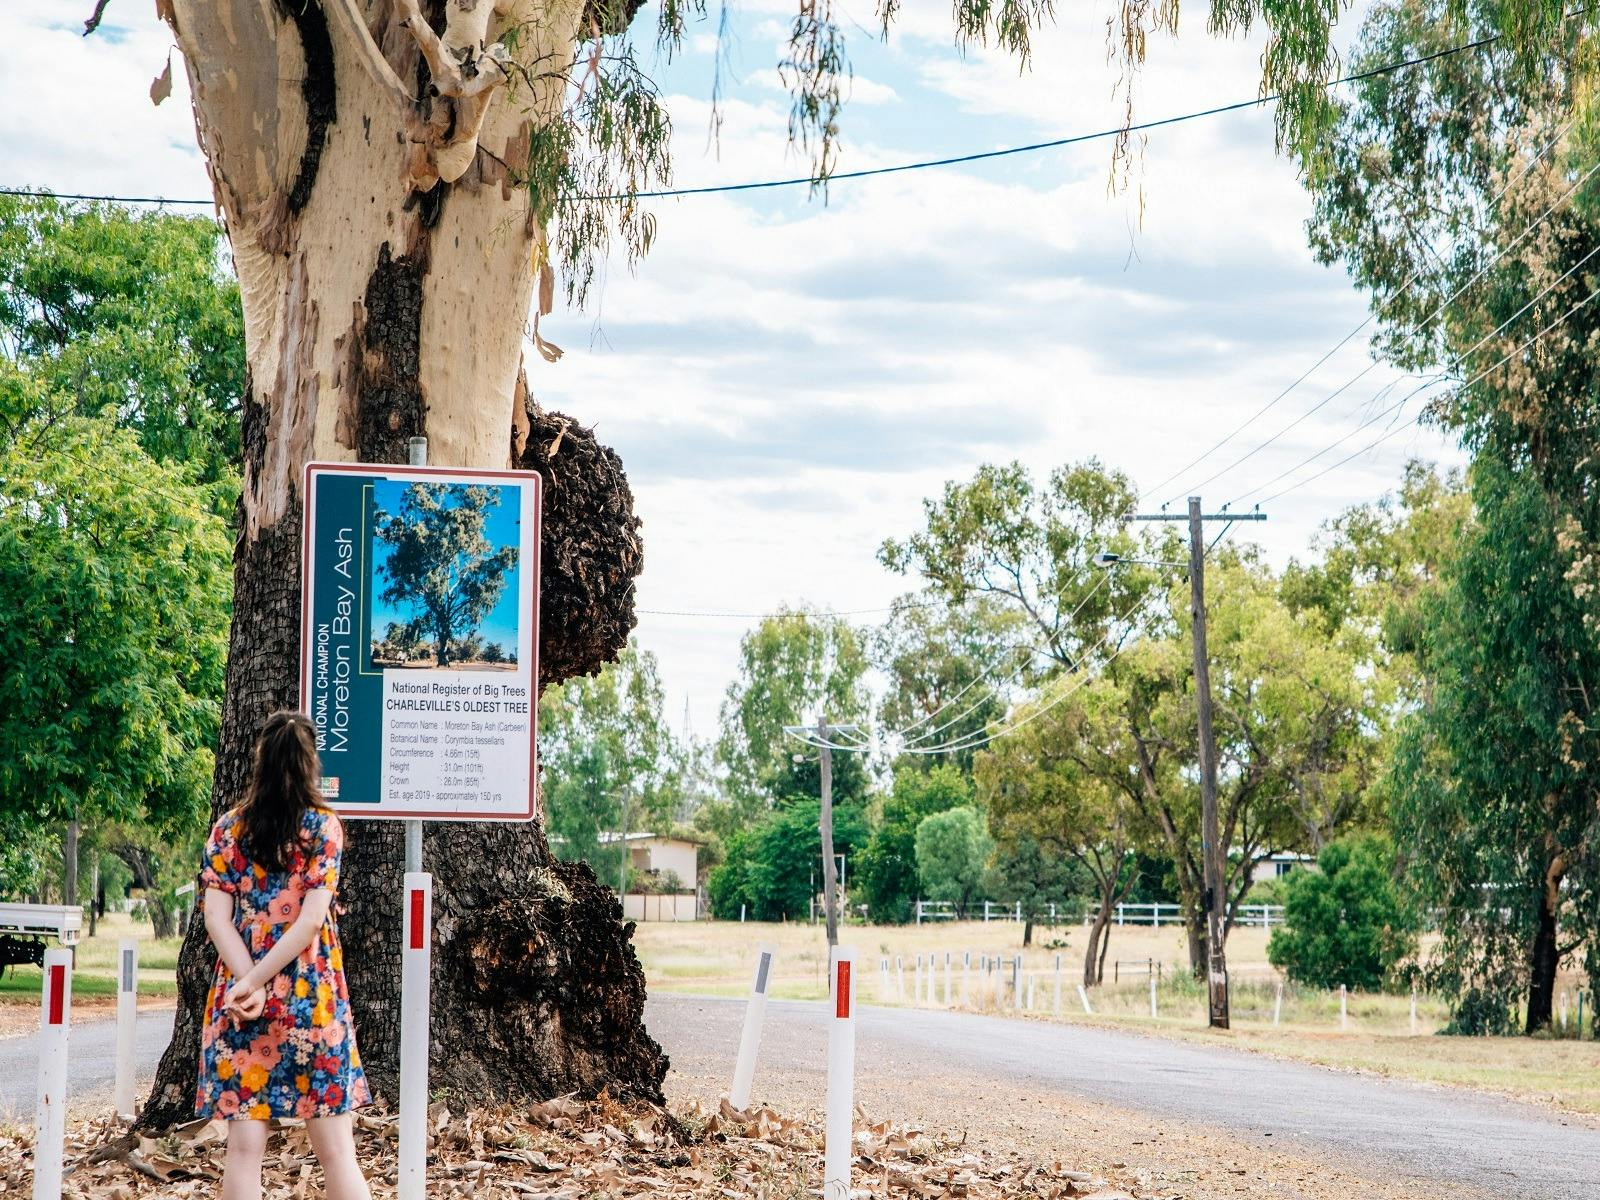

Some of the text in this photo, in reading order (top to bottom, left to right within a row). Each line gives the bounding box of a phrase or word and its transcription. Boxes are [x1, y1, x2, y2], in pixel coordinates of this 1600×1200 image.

[330, 528, 355, 752] Moreton Bay Ash
[315, 623, 329, 751] NATIONAL CHAMPION
[392, 682, 526, 699] National Register of Big Trees
[386, 699, 529, 714] CHARLEVILLE'S OLDEST TREE
[390, 719, 419, 730] Common
[420, 720, 438, 730] Name
[444, 720, 470, 731] Moreton
[471, 721, 484, 733] Bay
[484, 722, 496, 732] Ash
[497, 721, 527, 733] (Carbeen)
[390, 733, 419, 744] Botanical
[420, 734, 438, 744] Name
[444, 734, 474, 747] Corymbia
[389, 747, 434, 758] Circumference
[464, 749, 481, 760] (15ft)
[389, 761, 410, 773] Height
[443, 762, 463, 772] 31.0m
[464, 763, 484, 774] (101ft)
[389, 775, 410, 785] Crown
[443, 776, 463, 786] 26.0m
[388, 789, 400, 800] Est.
[402, 792, 414, 802] age
[414, 790, 431, 800] 2019
[435, 791, 478, 802] approximately
[480, 791, 492, 801] 150
[492, 793, 502, 803] yrs
